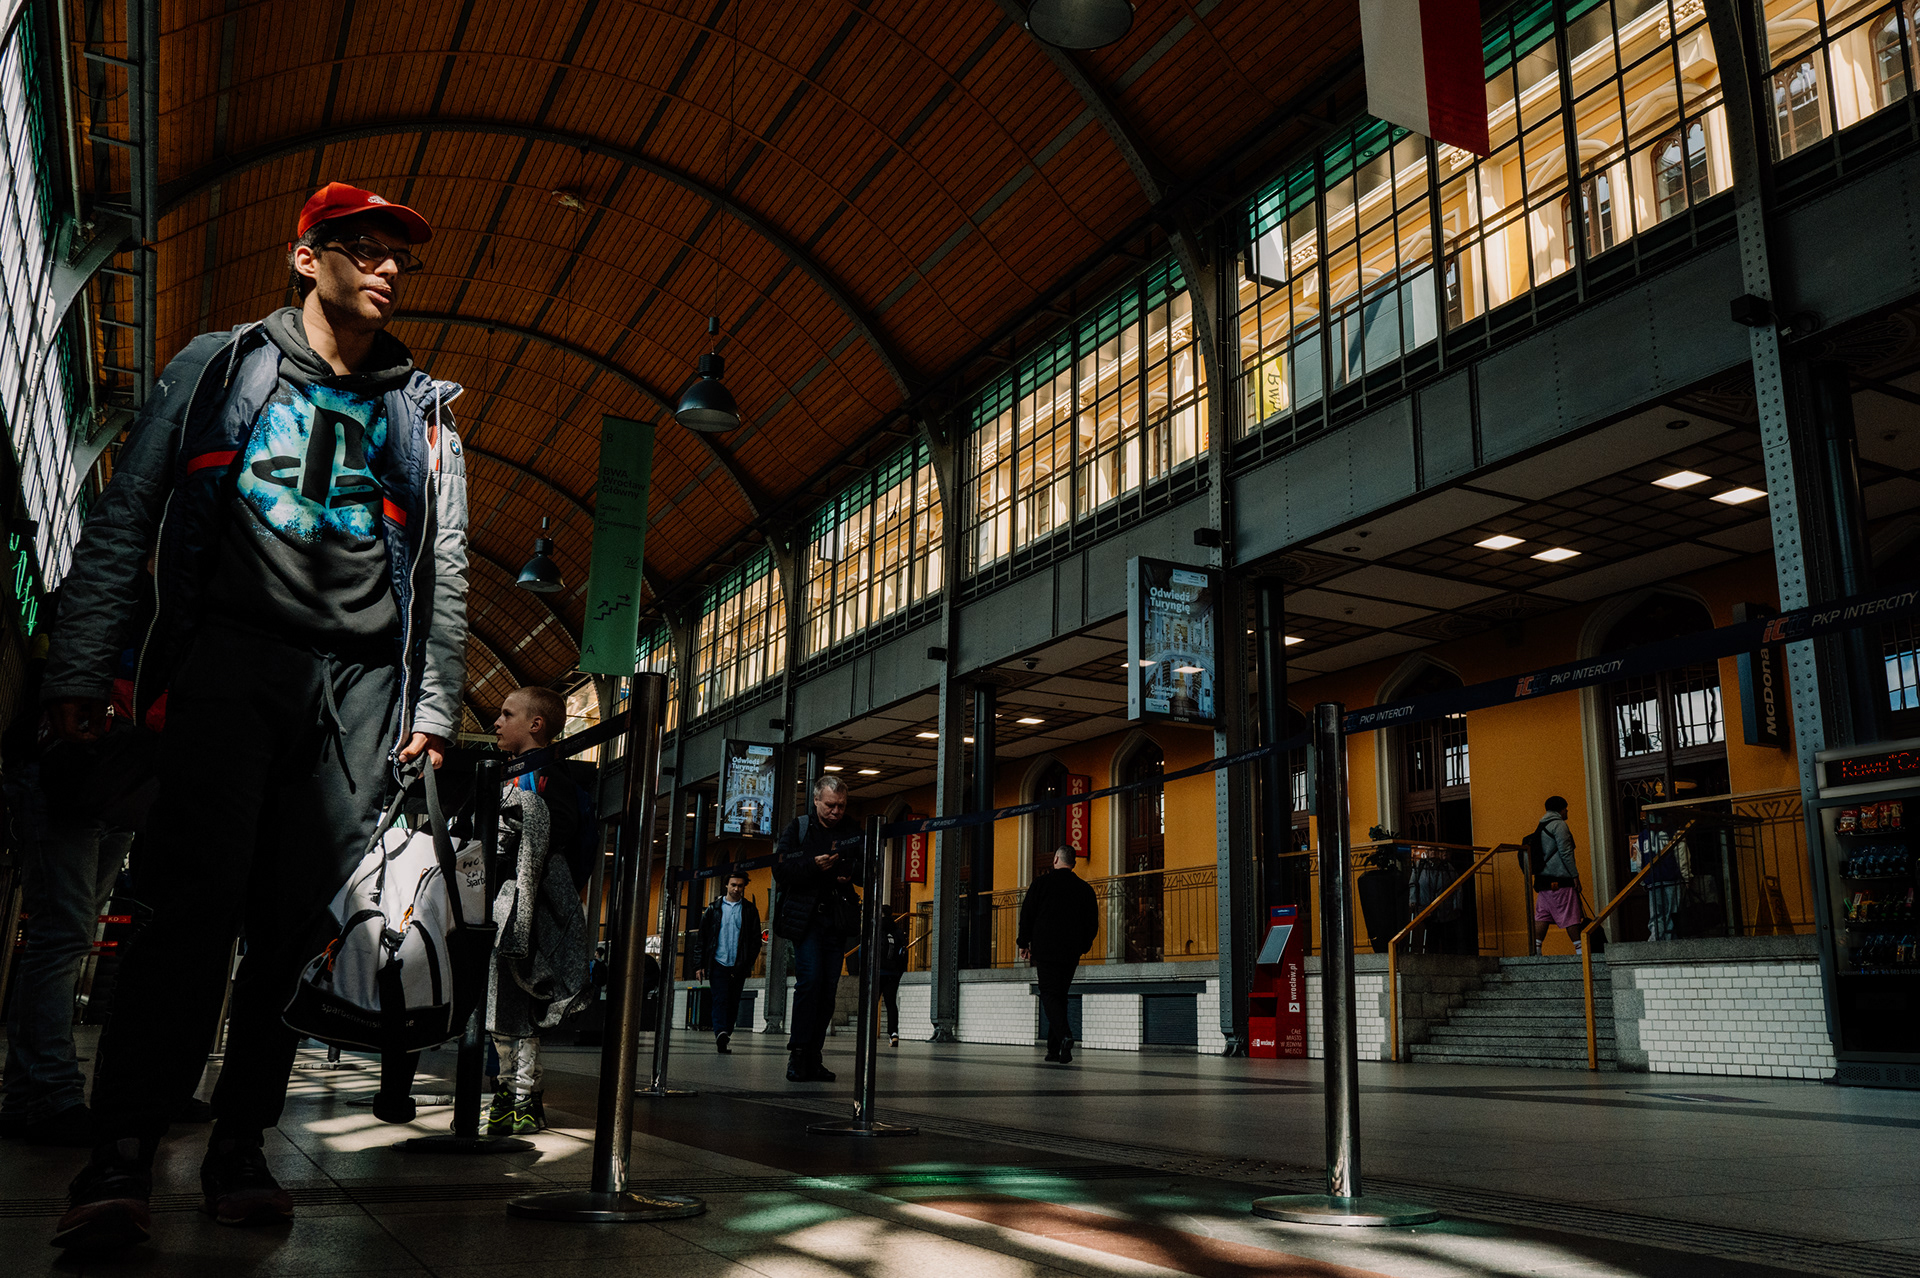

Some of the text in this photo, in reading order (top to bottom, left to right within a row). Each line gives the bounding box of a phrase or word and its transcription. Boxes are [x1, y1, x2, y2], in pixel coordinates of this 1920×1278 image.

[606, 433, 614, 442] B
[603, 466, 628, 478] BWA
[602, 475, 646, 491] Wrocław
[1150, 586, 1190, 602] Odwiedź
[1150, 596, 1190, 615] Turyngię
[1811, 609, 1841, 627] PKP
[1843, 590, 1919, 620] INTERCITY
[585, 644, 595, 654] A
[1549, 671, 1571, 686] PKP
[1572, 659, 1624, 681] INTERCITY
[1359, 704, 1416, 725] PKP INTERCITY
